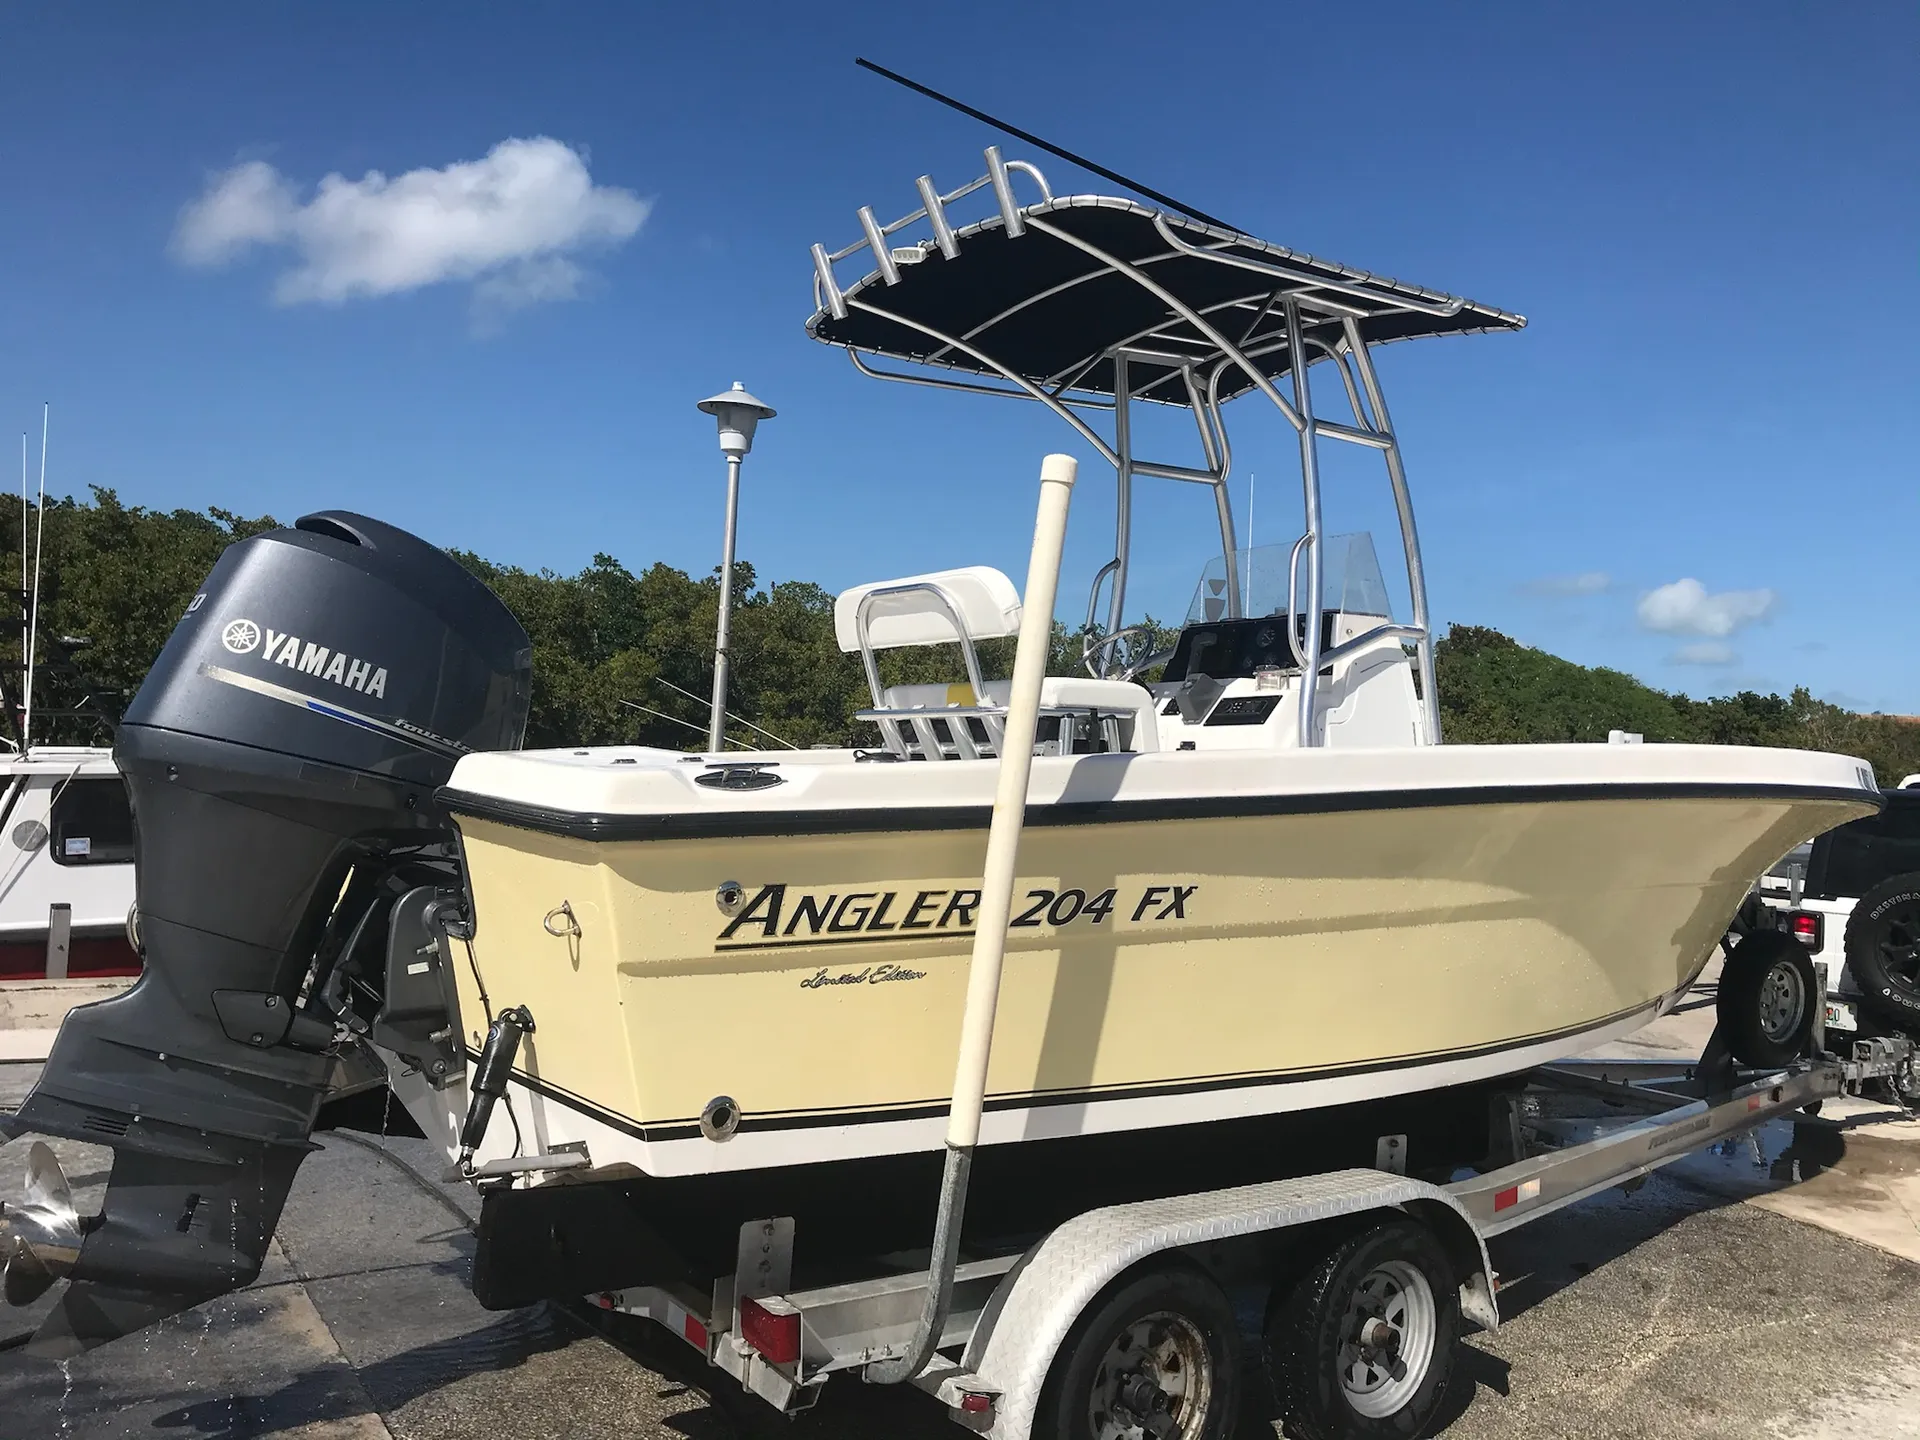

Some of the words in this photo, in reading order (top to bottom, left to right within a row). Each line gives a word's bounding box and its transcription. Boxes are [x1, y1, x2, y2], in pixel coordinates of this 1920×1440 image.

[262, 628, 389, 699] YAMAHA
[716, 883, 983, 939] ANGLER
[1008, 889, 1117, 926] 204
[1130, 885, 1199, 920] FX
[800, 967, 871, 989] Limited
[869, 964, 928, 985] Edition
